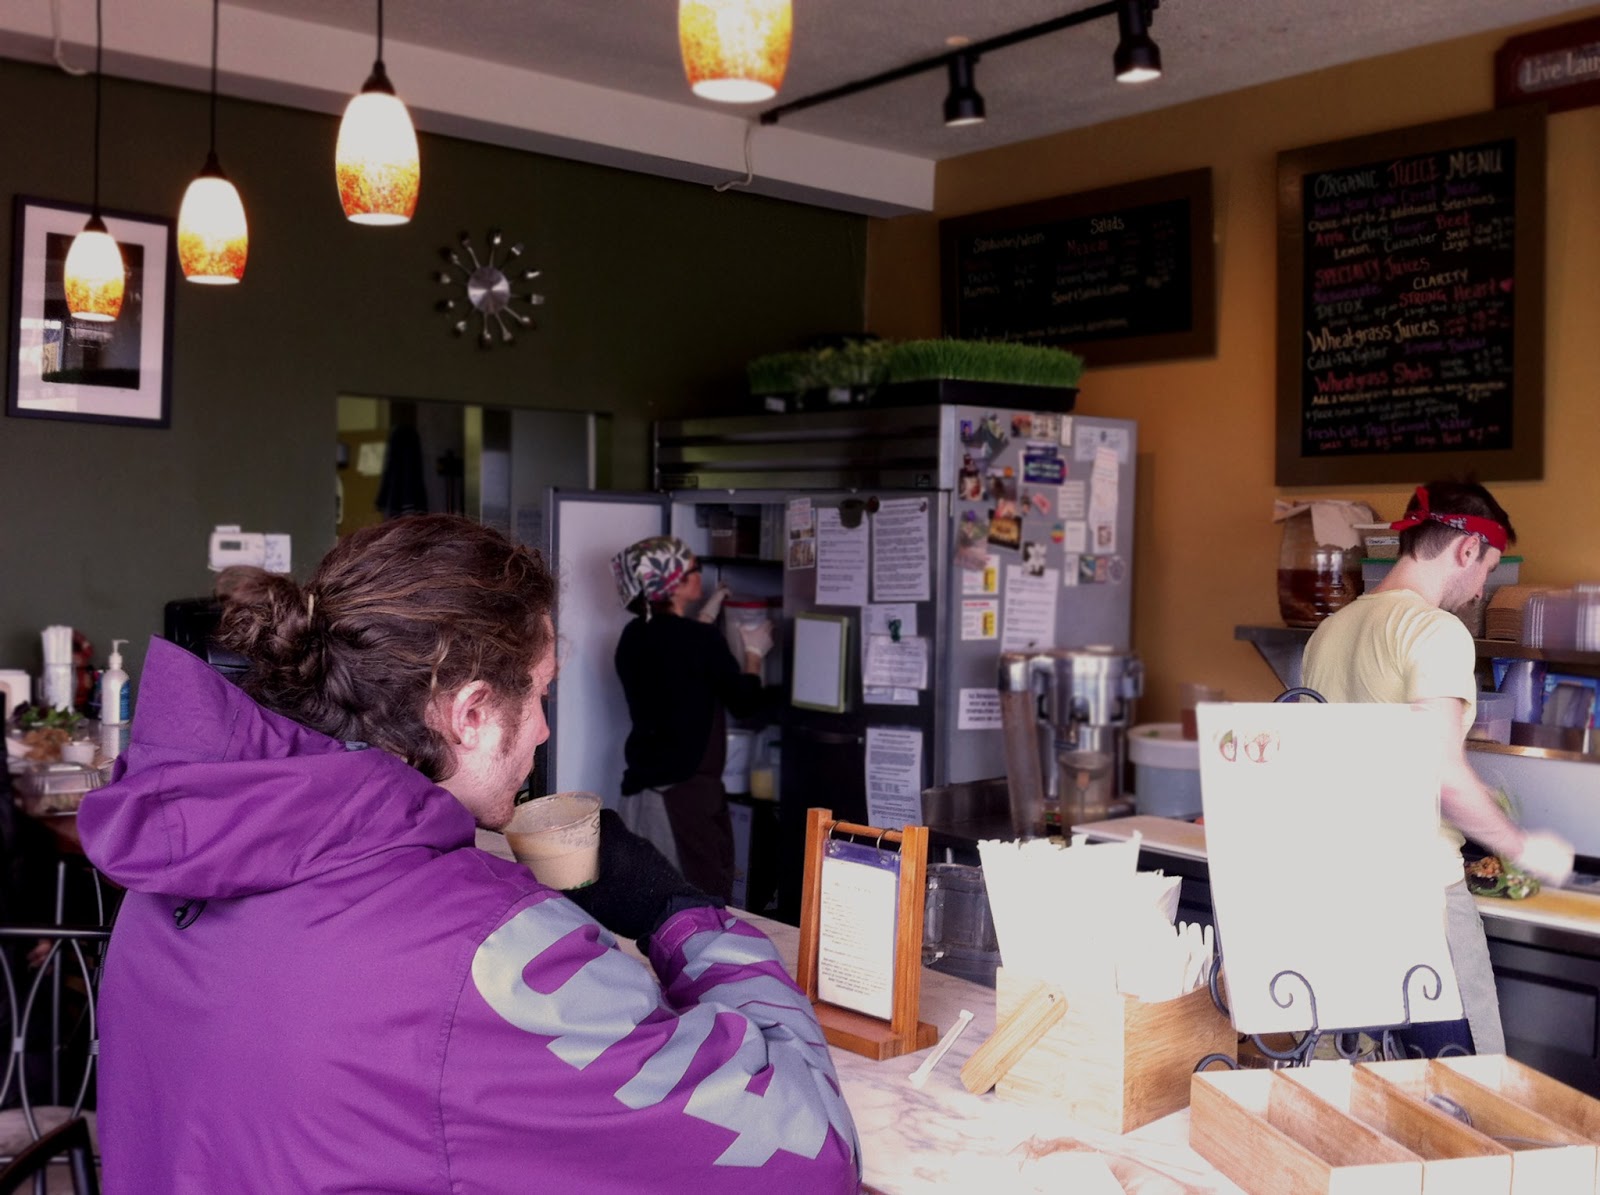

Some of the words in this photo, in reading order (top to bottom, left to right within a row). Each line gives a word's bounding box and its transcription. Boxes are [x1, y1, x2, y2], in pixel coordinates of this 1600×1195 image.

[1525, 58, 1562, 86] Live
[1566, 50, 1600, 77] Lau
[1314, 169, 1379, 199] ORGANIC
[1386, 156, 1440, 189] JUICE
[1445, 147, 1503, 181] MENU
[1090, 215, 1126, 235] Salads
[1352, 223, 1390, 243] Celery
[1435, 208, 1471, 230] Beet
[1383, 232, 1438, 254] Cucumber
[1383, 254, 1431, 282] Juices
[1412, 267, 1469, 291] CLARITY
[1398, 290, 1448, 308] STRONG
[1453, 277, 1498, 302] Heart
[1314, 298, 1364, 320] DETOX
[1306, 323, 1392, 354] Wheatgrass
[1393, 317, 1440, 344] Juices
[1314, 369, 1390, 393] Wheatgrass
